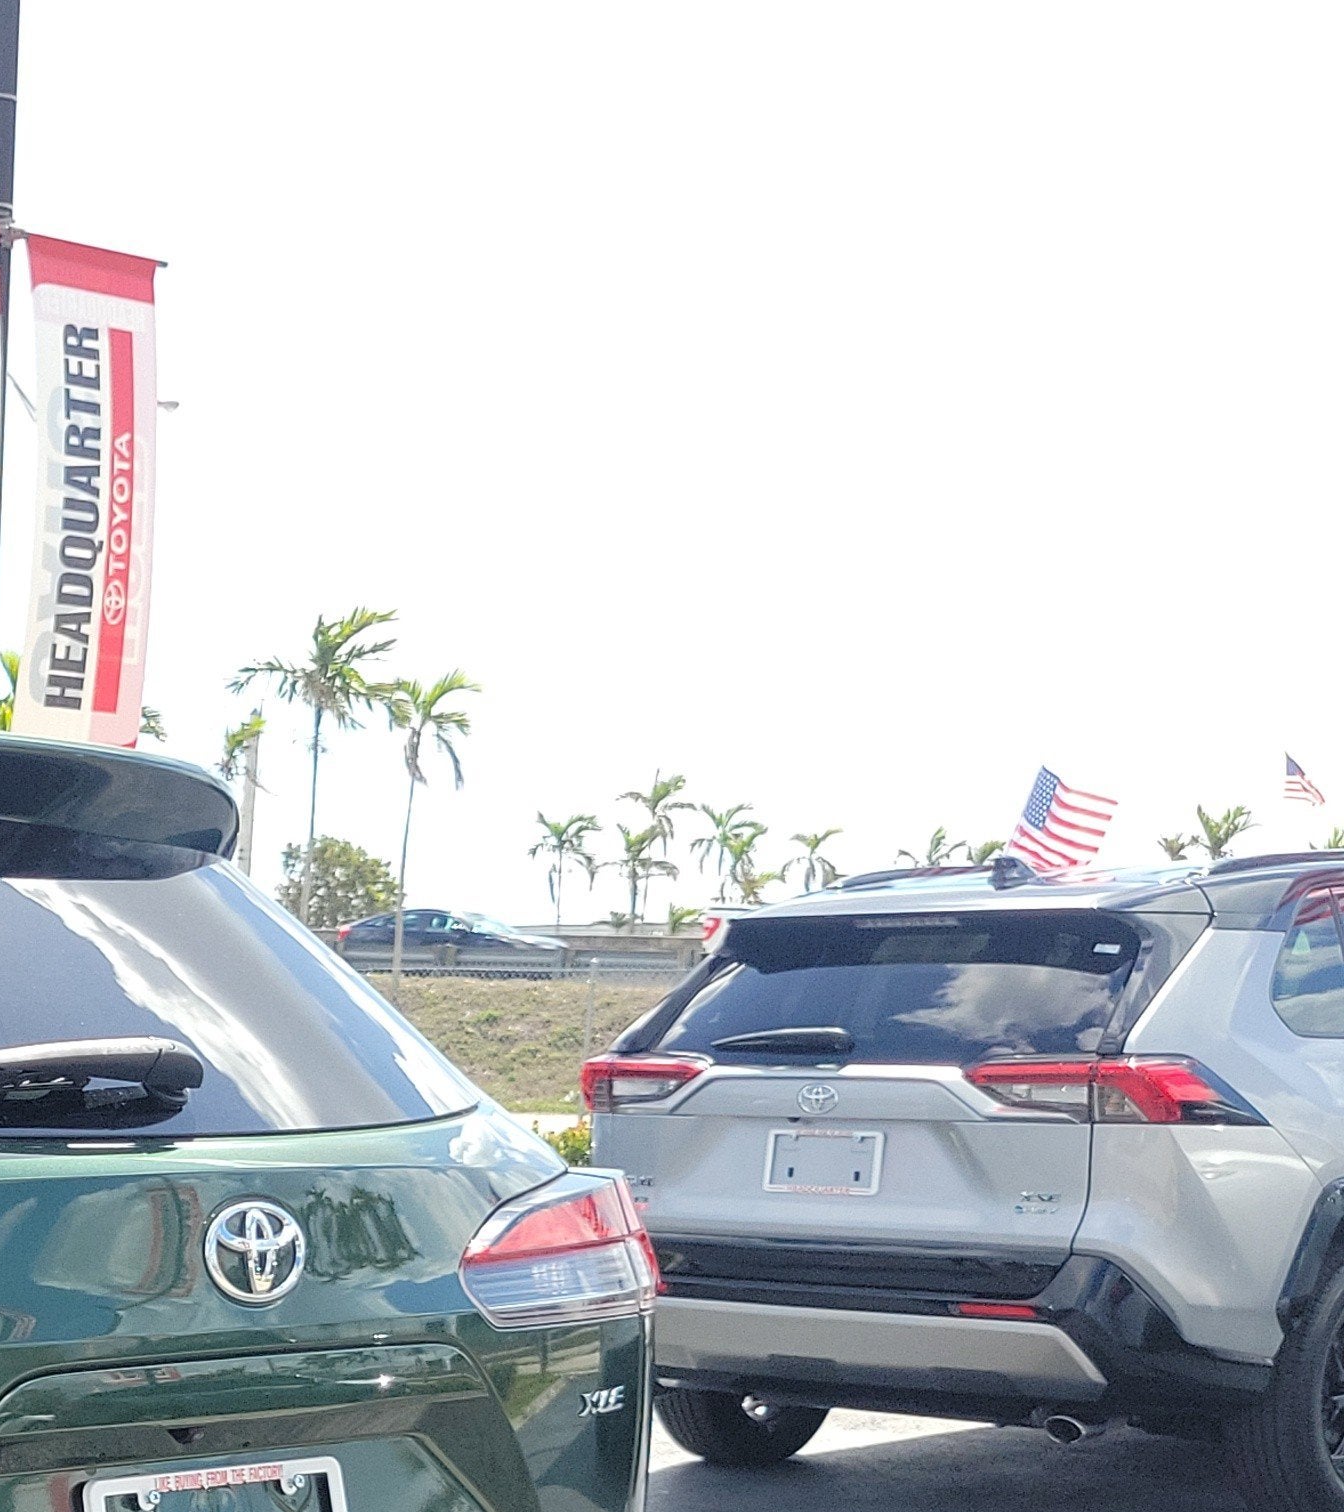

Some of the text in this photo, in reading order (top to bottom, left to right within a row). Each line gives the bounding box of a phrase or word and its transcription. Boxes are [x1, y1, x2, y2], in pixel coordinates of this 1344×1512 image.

[45, 323, 104, 711] HEADQUARTER
[109, 432, 133, 571] TOYOTA
[577, 1385, 624, 1417] XLE
